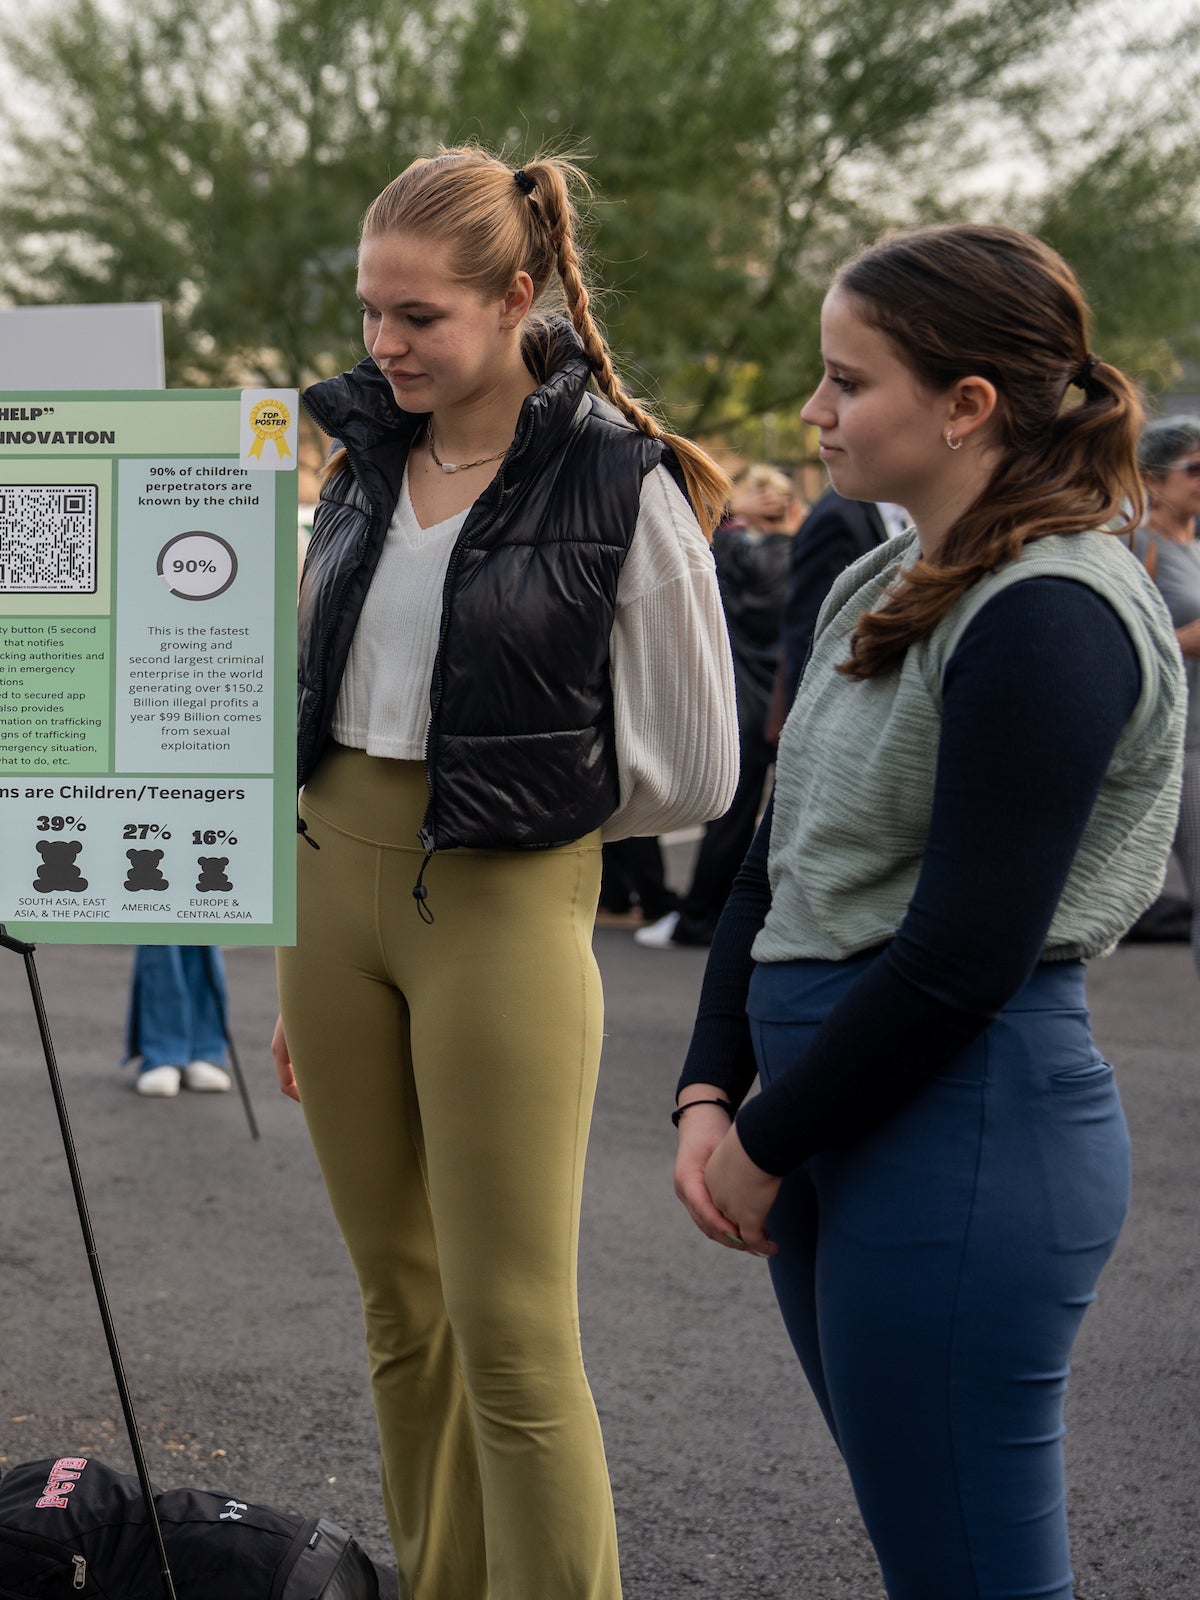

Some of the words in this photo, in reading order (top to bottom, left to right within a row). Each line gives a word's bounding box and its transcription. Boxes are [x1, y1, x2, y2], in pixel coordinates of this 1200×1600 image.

[254, 419, 287, 427] POSTER
[150, 467, 176, 476] 90%
[179, 466, 192, 476] of
[195, 466, 248, 476] children
[146, 483, 227, 494] perpetrators
[138, 496, 181, 506] known
[185, 496, 200, 508] by
[203, 496, 225, 506] the
[228, 496, 259, 505] child
[173, 559, 217, 573] 90%
[11, 625, 44, 634] button
[47, 625, 58, 635] (5
[60, 626, 96, 634] second
[4, 638, 24, 647] that
[27, 638, 64, 647] notifies
[29, 651, 83, 660] authorities
[85, 652, 105, 660] and
[129, 655, 170, 664] second
[174, 655, 213, 667] largest
[217, 655, 264, 664] criminal
[129, 669, 190, 681] enterprise
[193, 669, 204, 678] in
[207, 669, 226, 679] the
[229, 669, 263, 679] world
[128, 683, 192, 695] generating
[224, 683, 263, 693] $150.2
[161, 741, 230, 752] exploitation
[25, 788, 54, 799] are
[60, 785, 245, 803] Children/Teenagers
[36, 815, 87, 832] 39%
[122, 824, 172, 840] 27%
[192, 830, 238, 845] 16%
[18, 897, 53, 906] SOUTH
[55, 898, 80, 907] ASIA,
[83, 898, 107, 906] EAST
[121, 903, 171, 912] AMERICAS
[189, 898, 229, 907] EUROPE
[232, 898, 240, 907] &
[14, 909, 38, 918] ASIA,
[41, 910, 49, 918] &
[51, 910, 70, 918] THE
[73, 910, 110, 918] PACIFIC
[176, 910, 221, 919] CENTRAL
[223, 911, 253, 919] ASAIA
